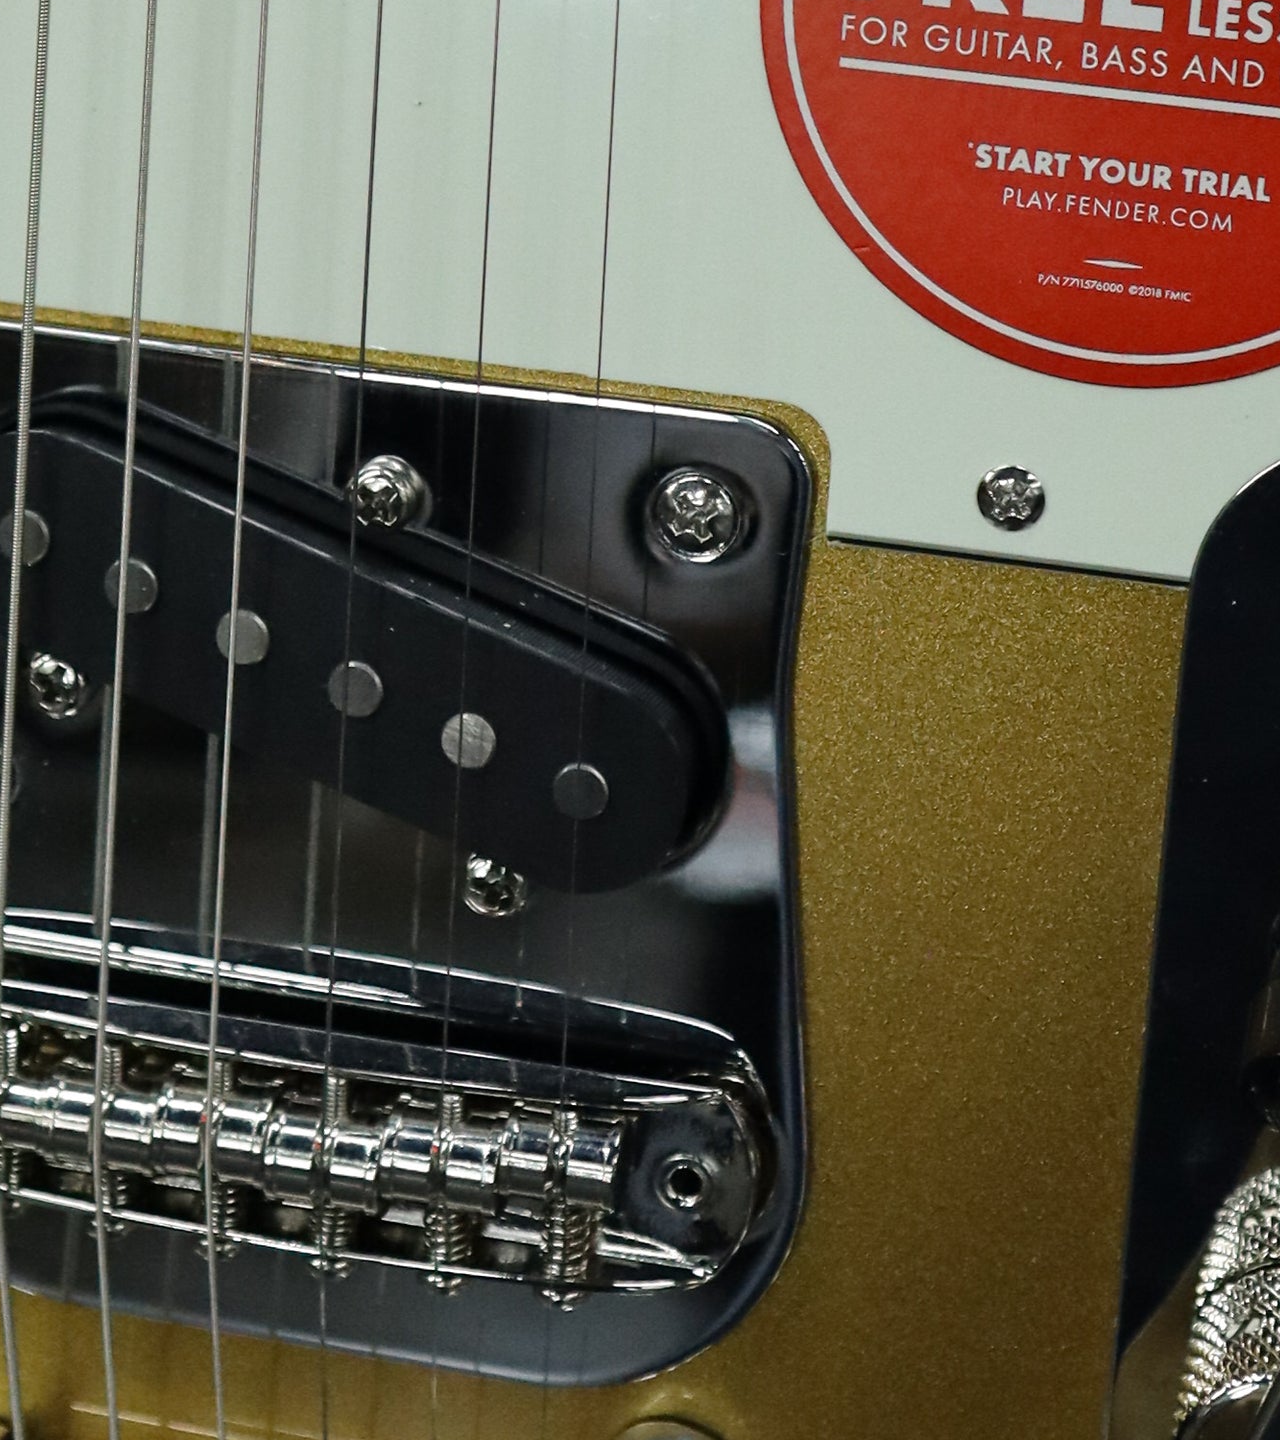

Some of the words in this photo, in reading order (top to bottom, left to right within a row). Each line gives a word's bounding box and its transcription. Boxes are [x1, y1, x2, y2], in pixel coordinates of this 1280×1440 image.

[840, 13, 909, 49] FOR
[923, 24, 1064, 71] GUITAR,
[1080, 41, 1169, 79] BASS
[1181, 53, 1266, 89] AND
[1078, 155, 1173, 192] YOUR
[1181, 167, 1272, 203] TRIAL
[1002, 186, 1234, 234] PLAY.FENDER.COM
[1037, 273, 1061, 287] P/N
[1164, 289, 1192, 303] FMIC
